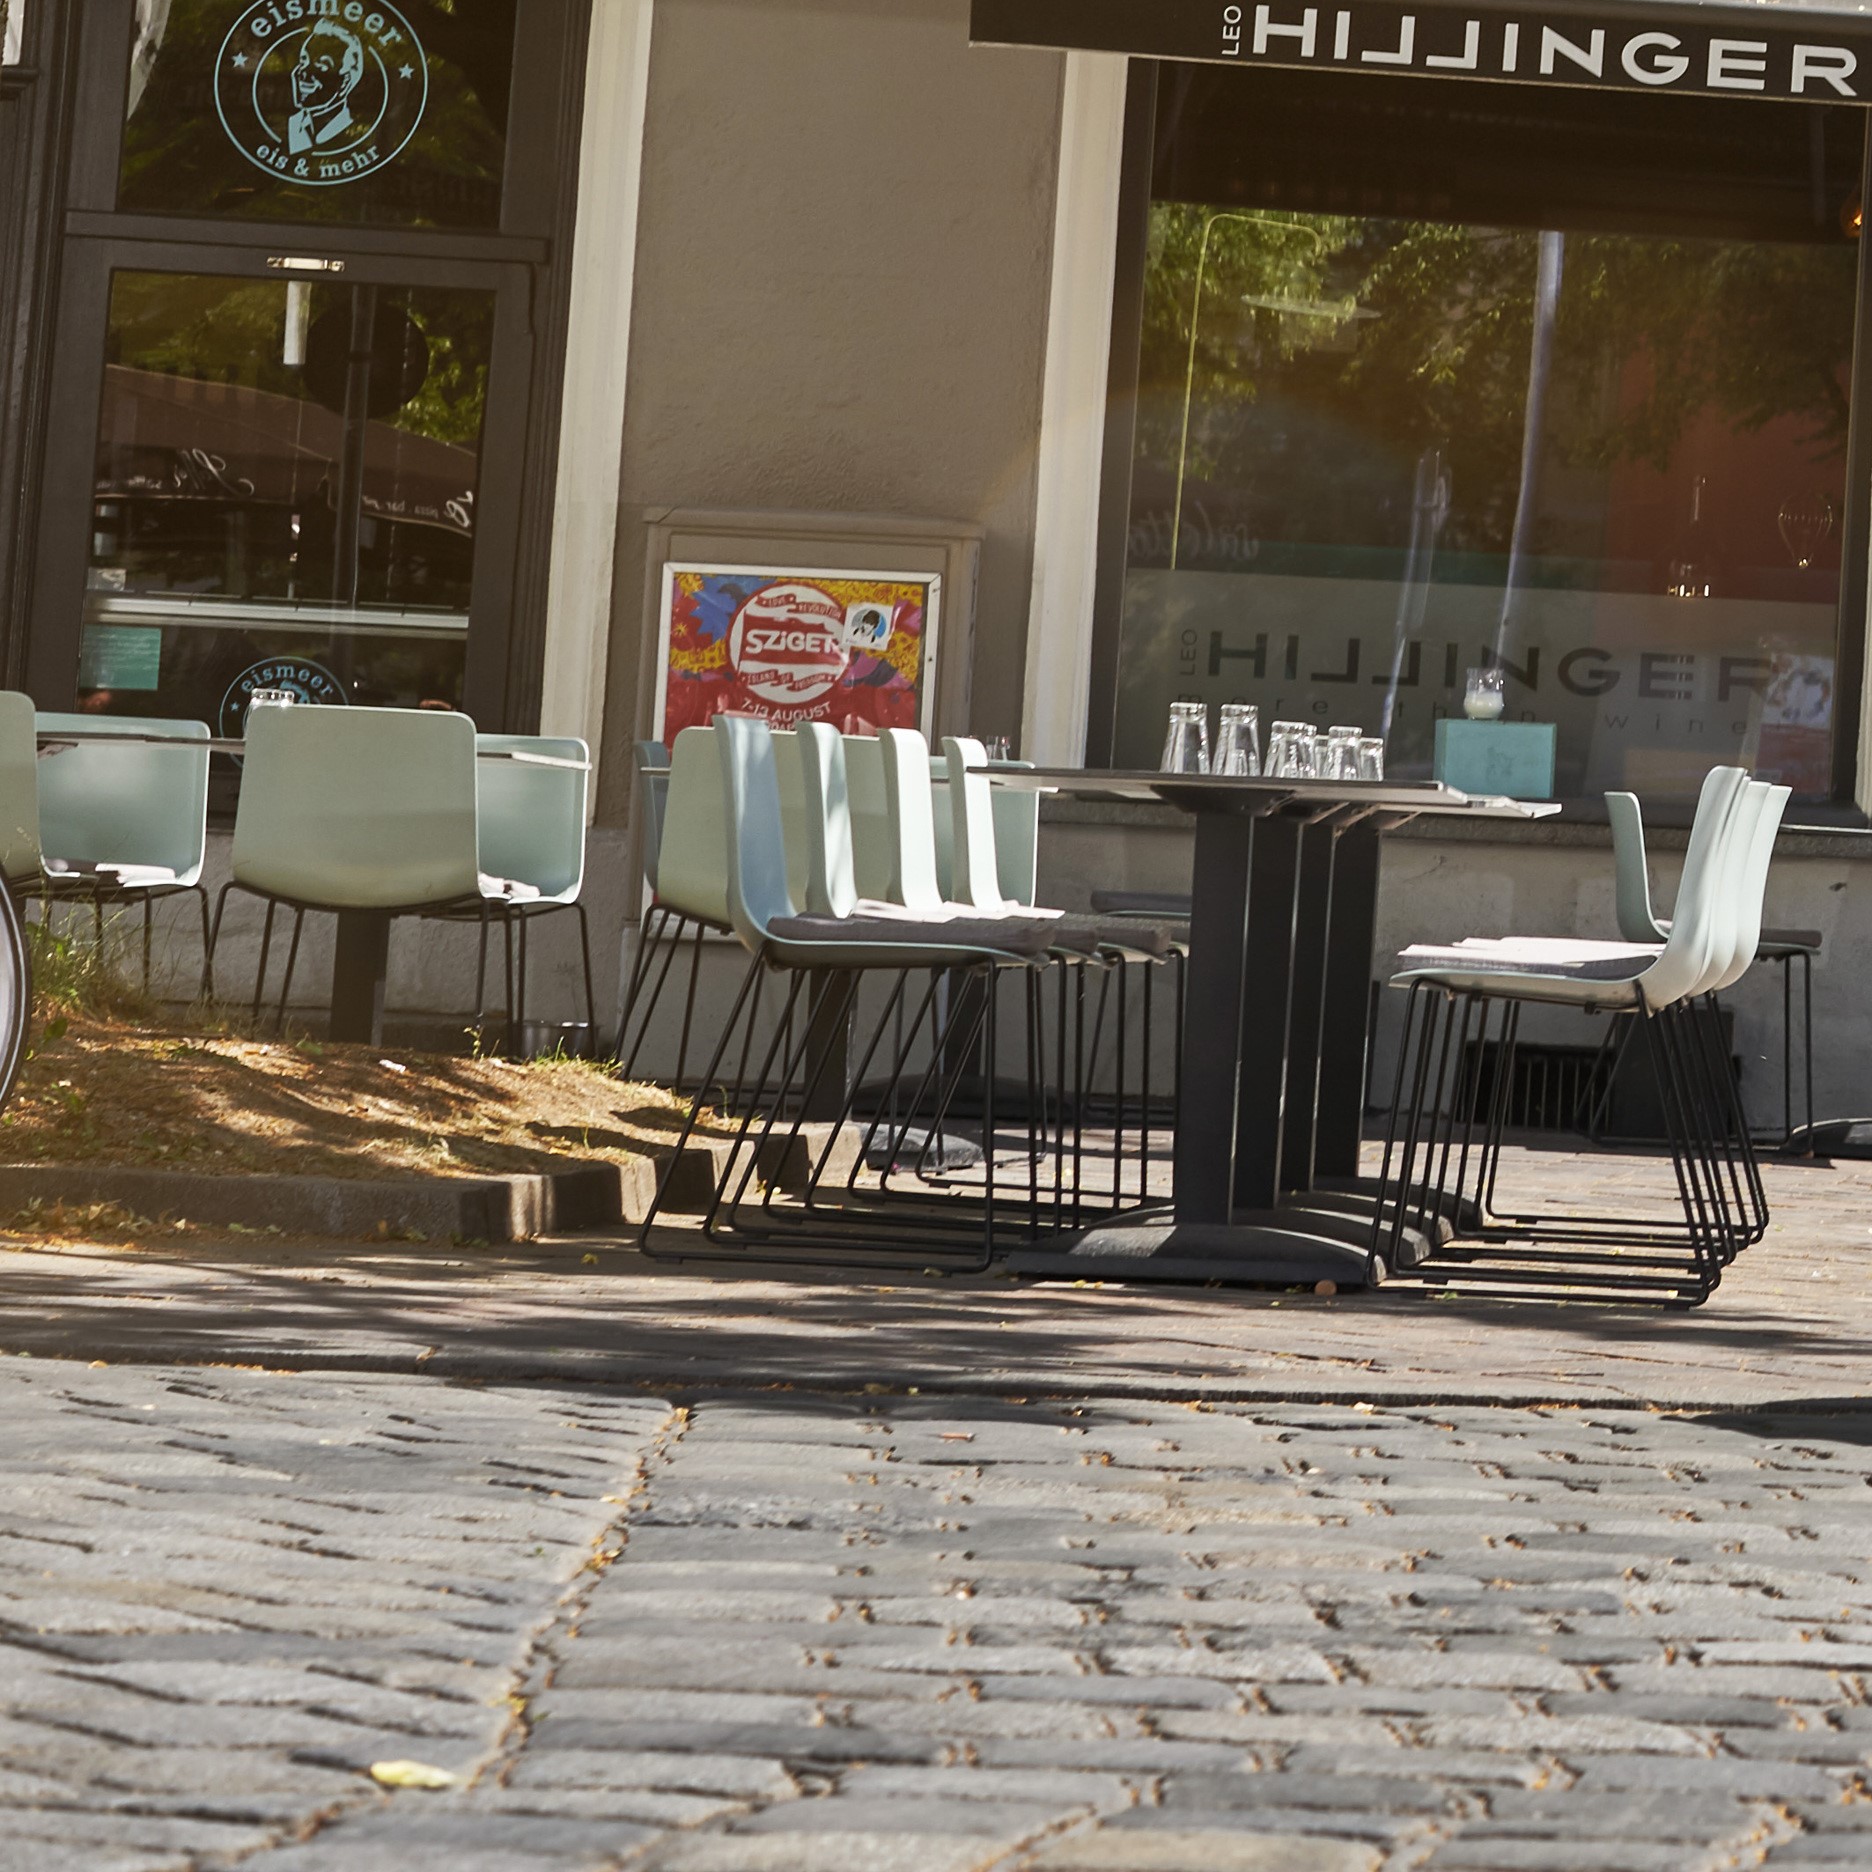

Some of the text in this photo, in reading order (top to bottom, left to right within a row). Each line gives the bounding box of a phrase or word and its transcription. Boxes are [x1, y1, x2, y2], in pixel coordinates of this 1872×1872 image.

[1222, 5, 1241, 56] LEO
[1253, 4, 1857, 96] HILLINGER
[256, 144, 380, 178] eis & mehr
[1180, 629, 1198, 676] LEO
[240, 665, 333, 697] eismeer
[741, 697, 831, 722] 7-13 AUGUST
